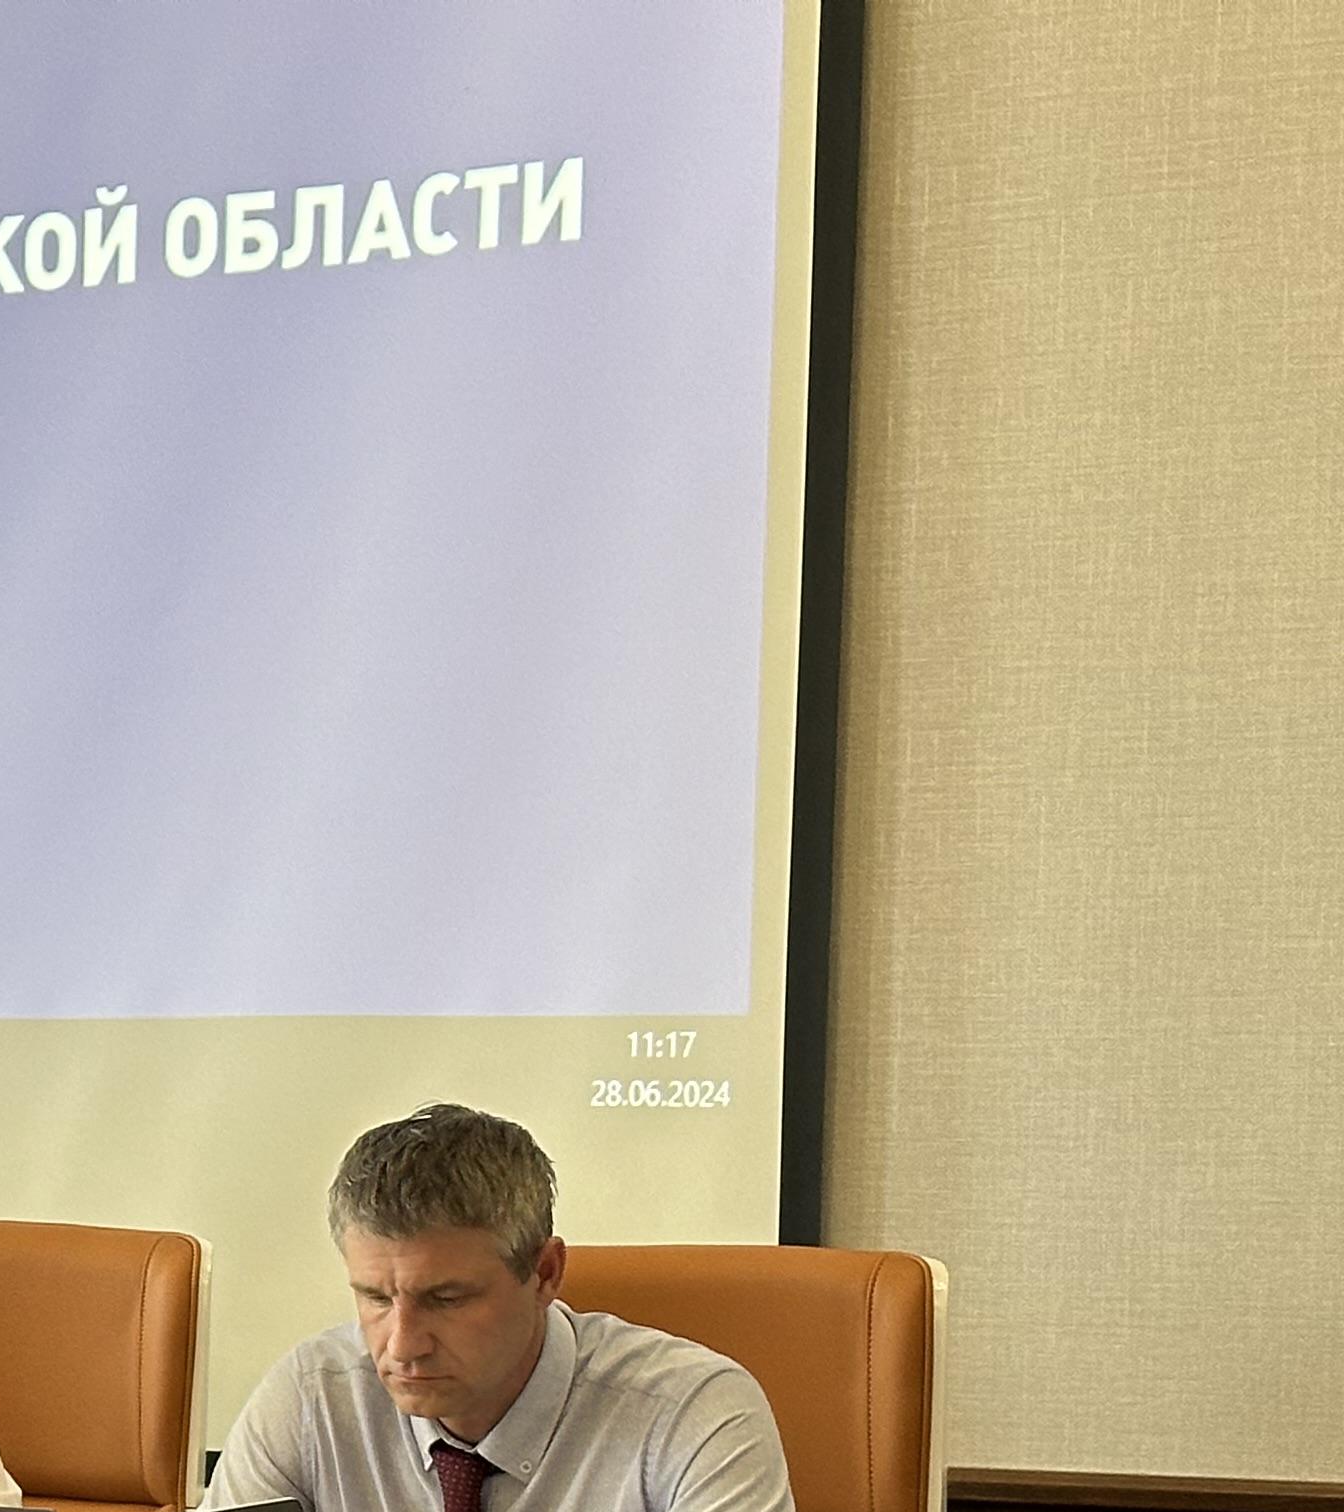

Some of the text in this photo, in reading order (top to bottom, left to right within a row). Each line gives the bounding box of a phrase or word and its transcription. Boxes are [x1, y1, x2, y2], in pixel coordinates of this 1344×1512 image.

[165, 156, 584, 278] ОБЛАСТИ
[626, 1031, 697, 1058] 11:17
[590, 1079, 731, 1108] 28.06.2024
